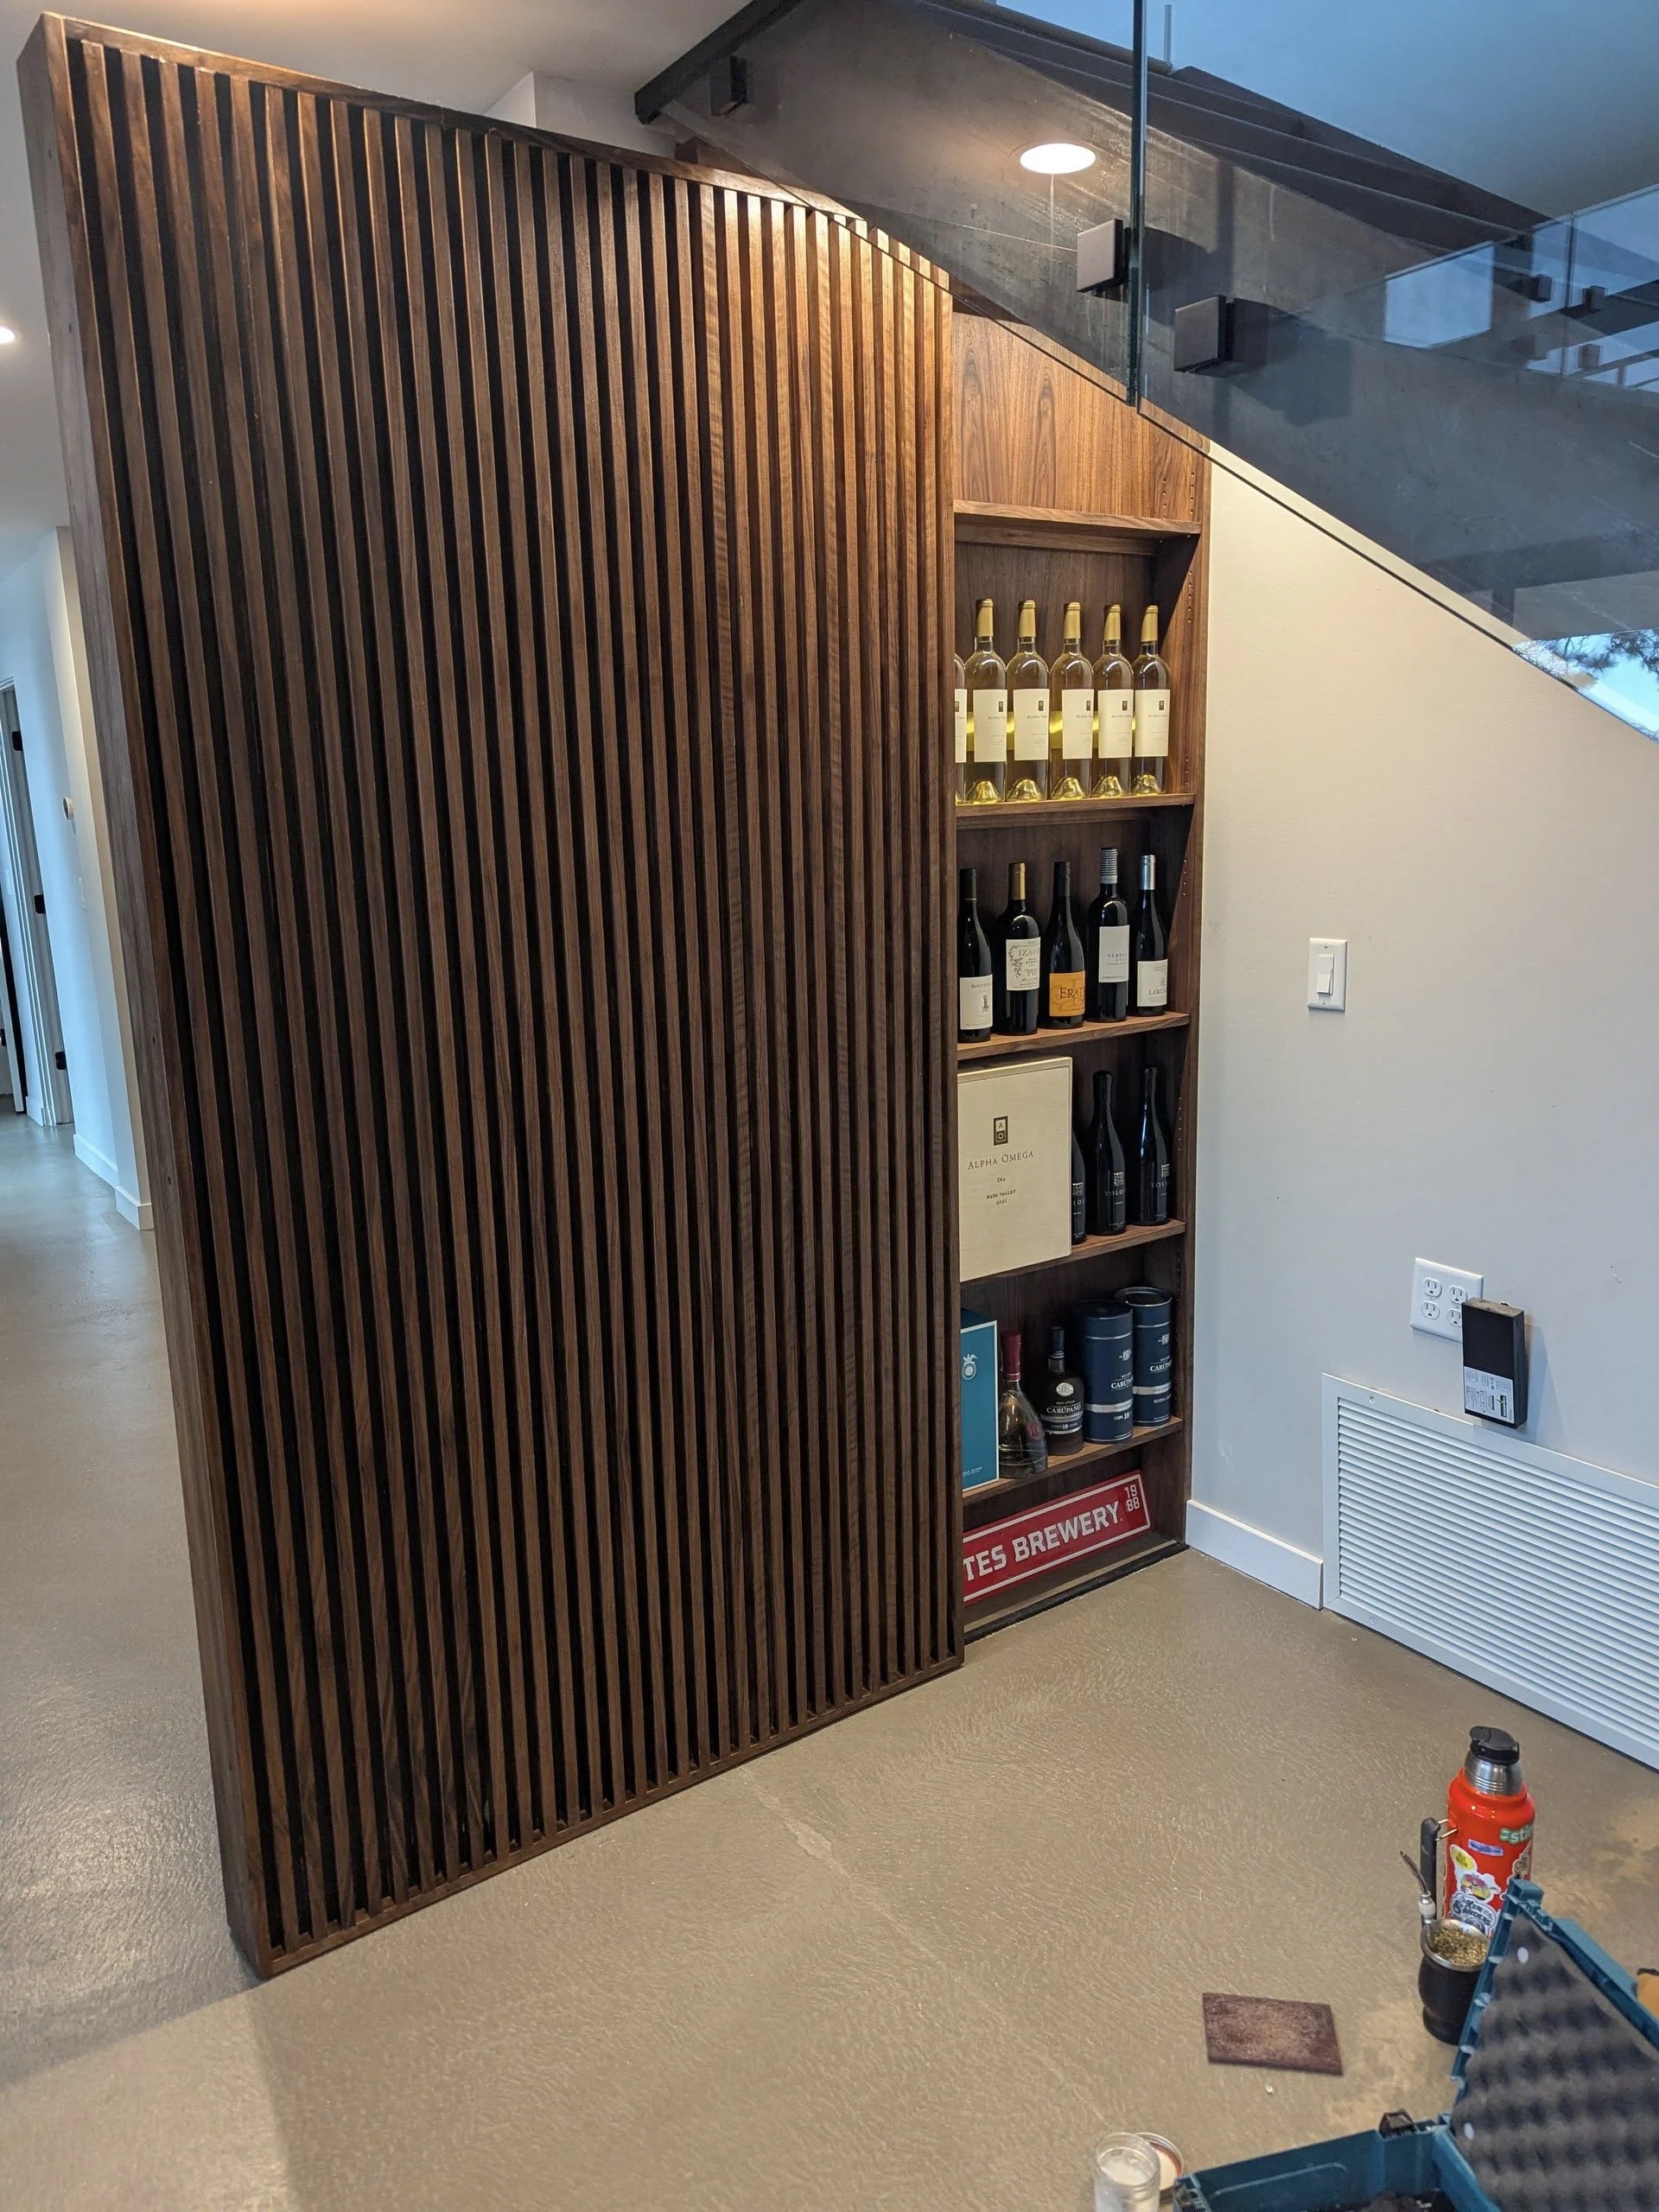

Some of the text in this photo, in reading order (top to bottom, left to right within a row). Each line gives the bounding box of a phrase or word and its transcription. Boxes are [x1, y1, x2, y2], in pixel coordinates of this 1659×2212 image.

[968, 1150, 1034, 1170] ALPHA OMEGA
[1124, 1484, 1137, 1499] 19
[1012, 1501, 1120, 1563] BREWERY
